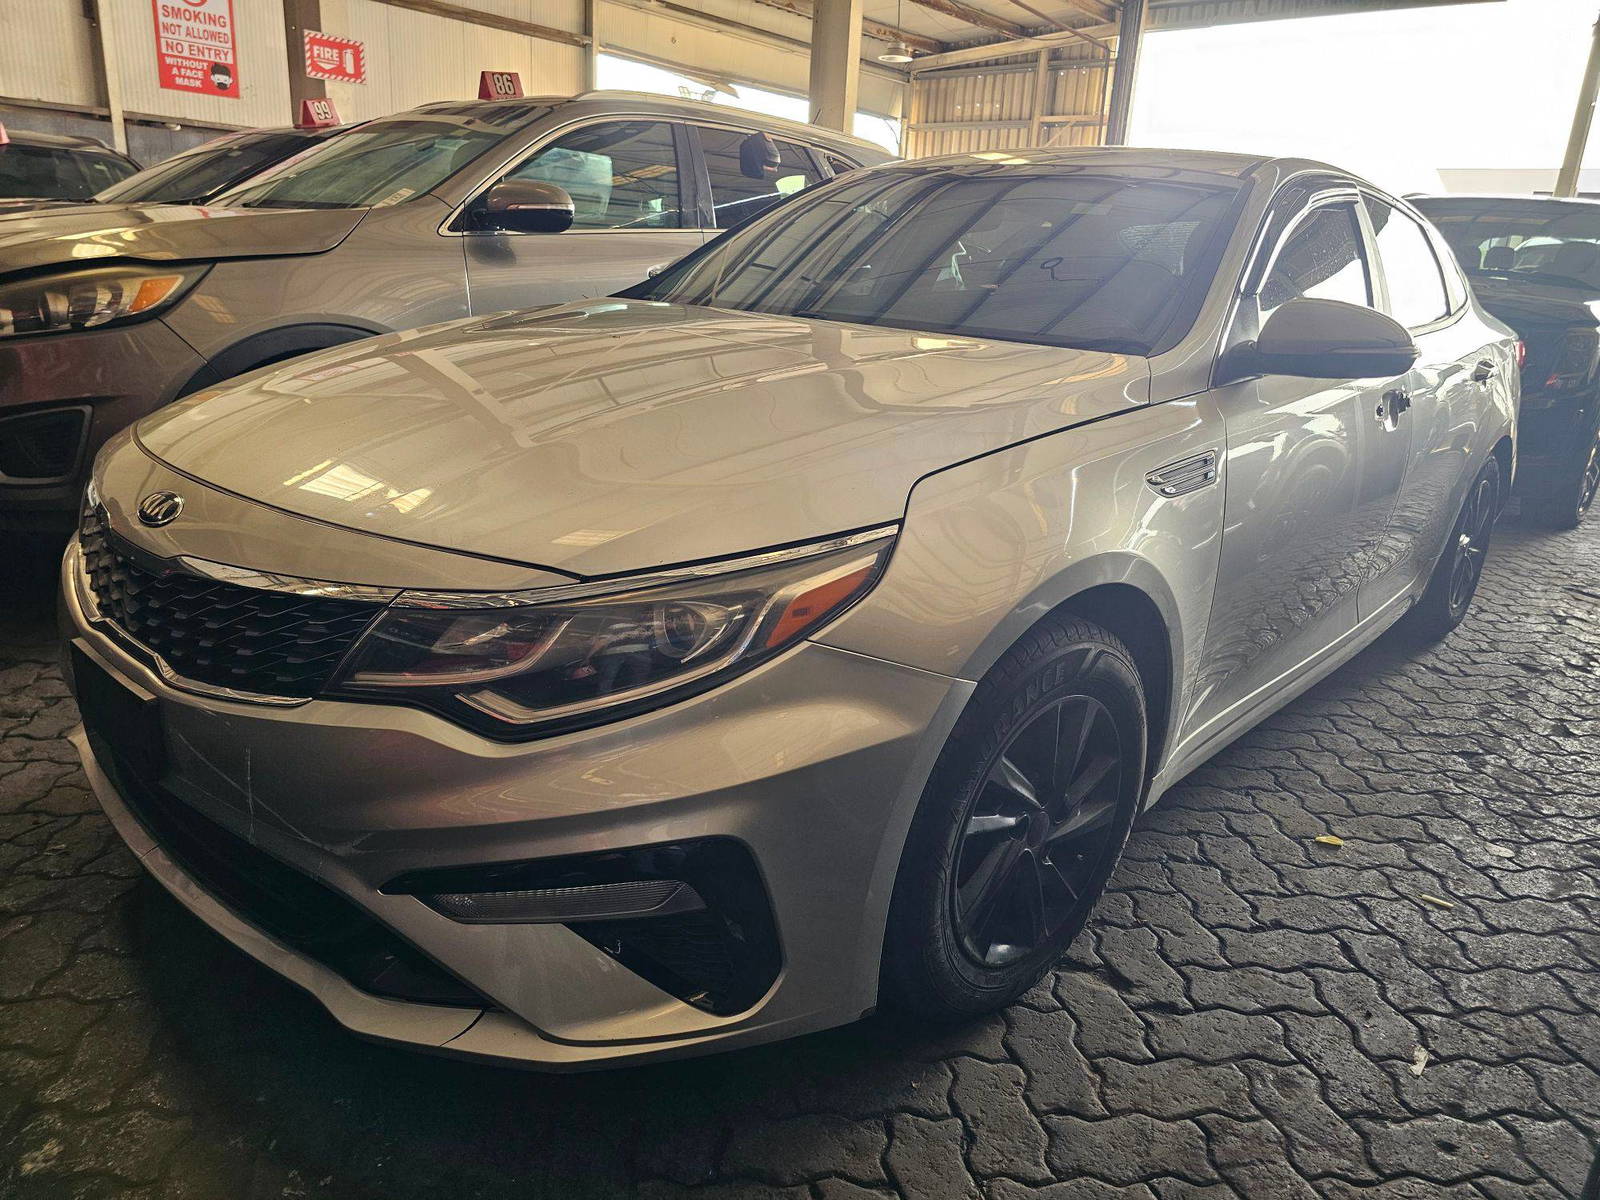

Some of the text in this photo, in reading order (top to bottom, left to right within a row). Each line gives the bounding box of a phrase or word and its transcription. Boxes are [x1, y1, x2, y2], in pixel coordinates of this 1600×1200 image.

[162, 5, 227, 28] SMOKING
[162, 22, 229, 44] NOT ALLOWED
[165, 40, 229, 61] NO ENTRY
[313, 45, 339, 60] FIRE
[165, 56, 208, 70] WITHOUT
[172, 67, 205, 79] A FACE
[175, 77, 202, 88] MASK
[493, 73, 515, 95] 86
[313, 101, 333, 120] 99
